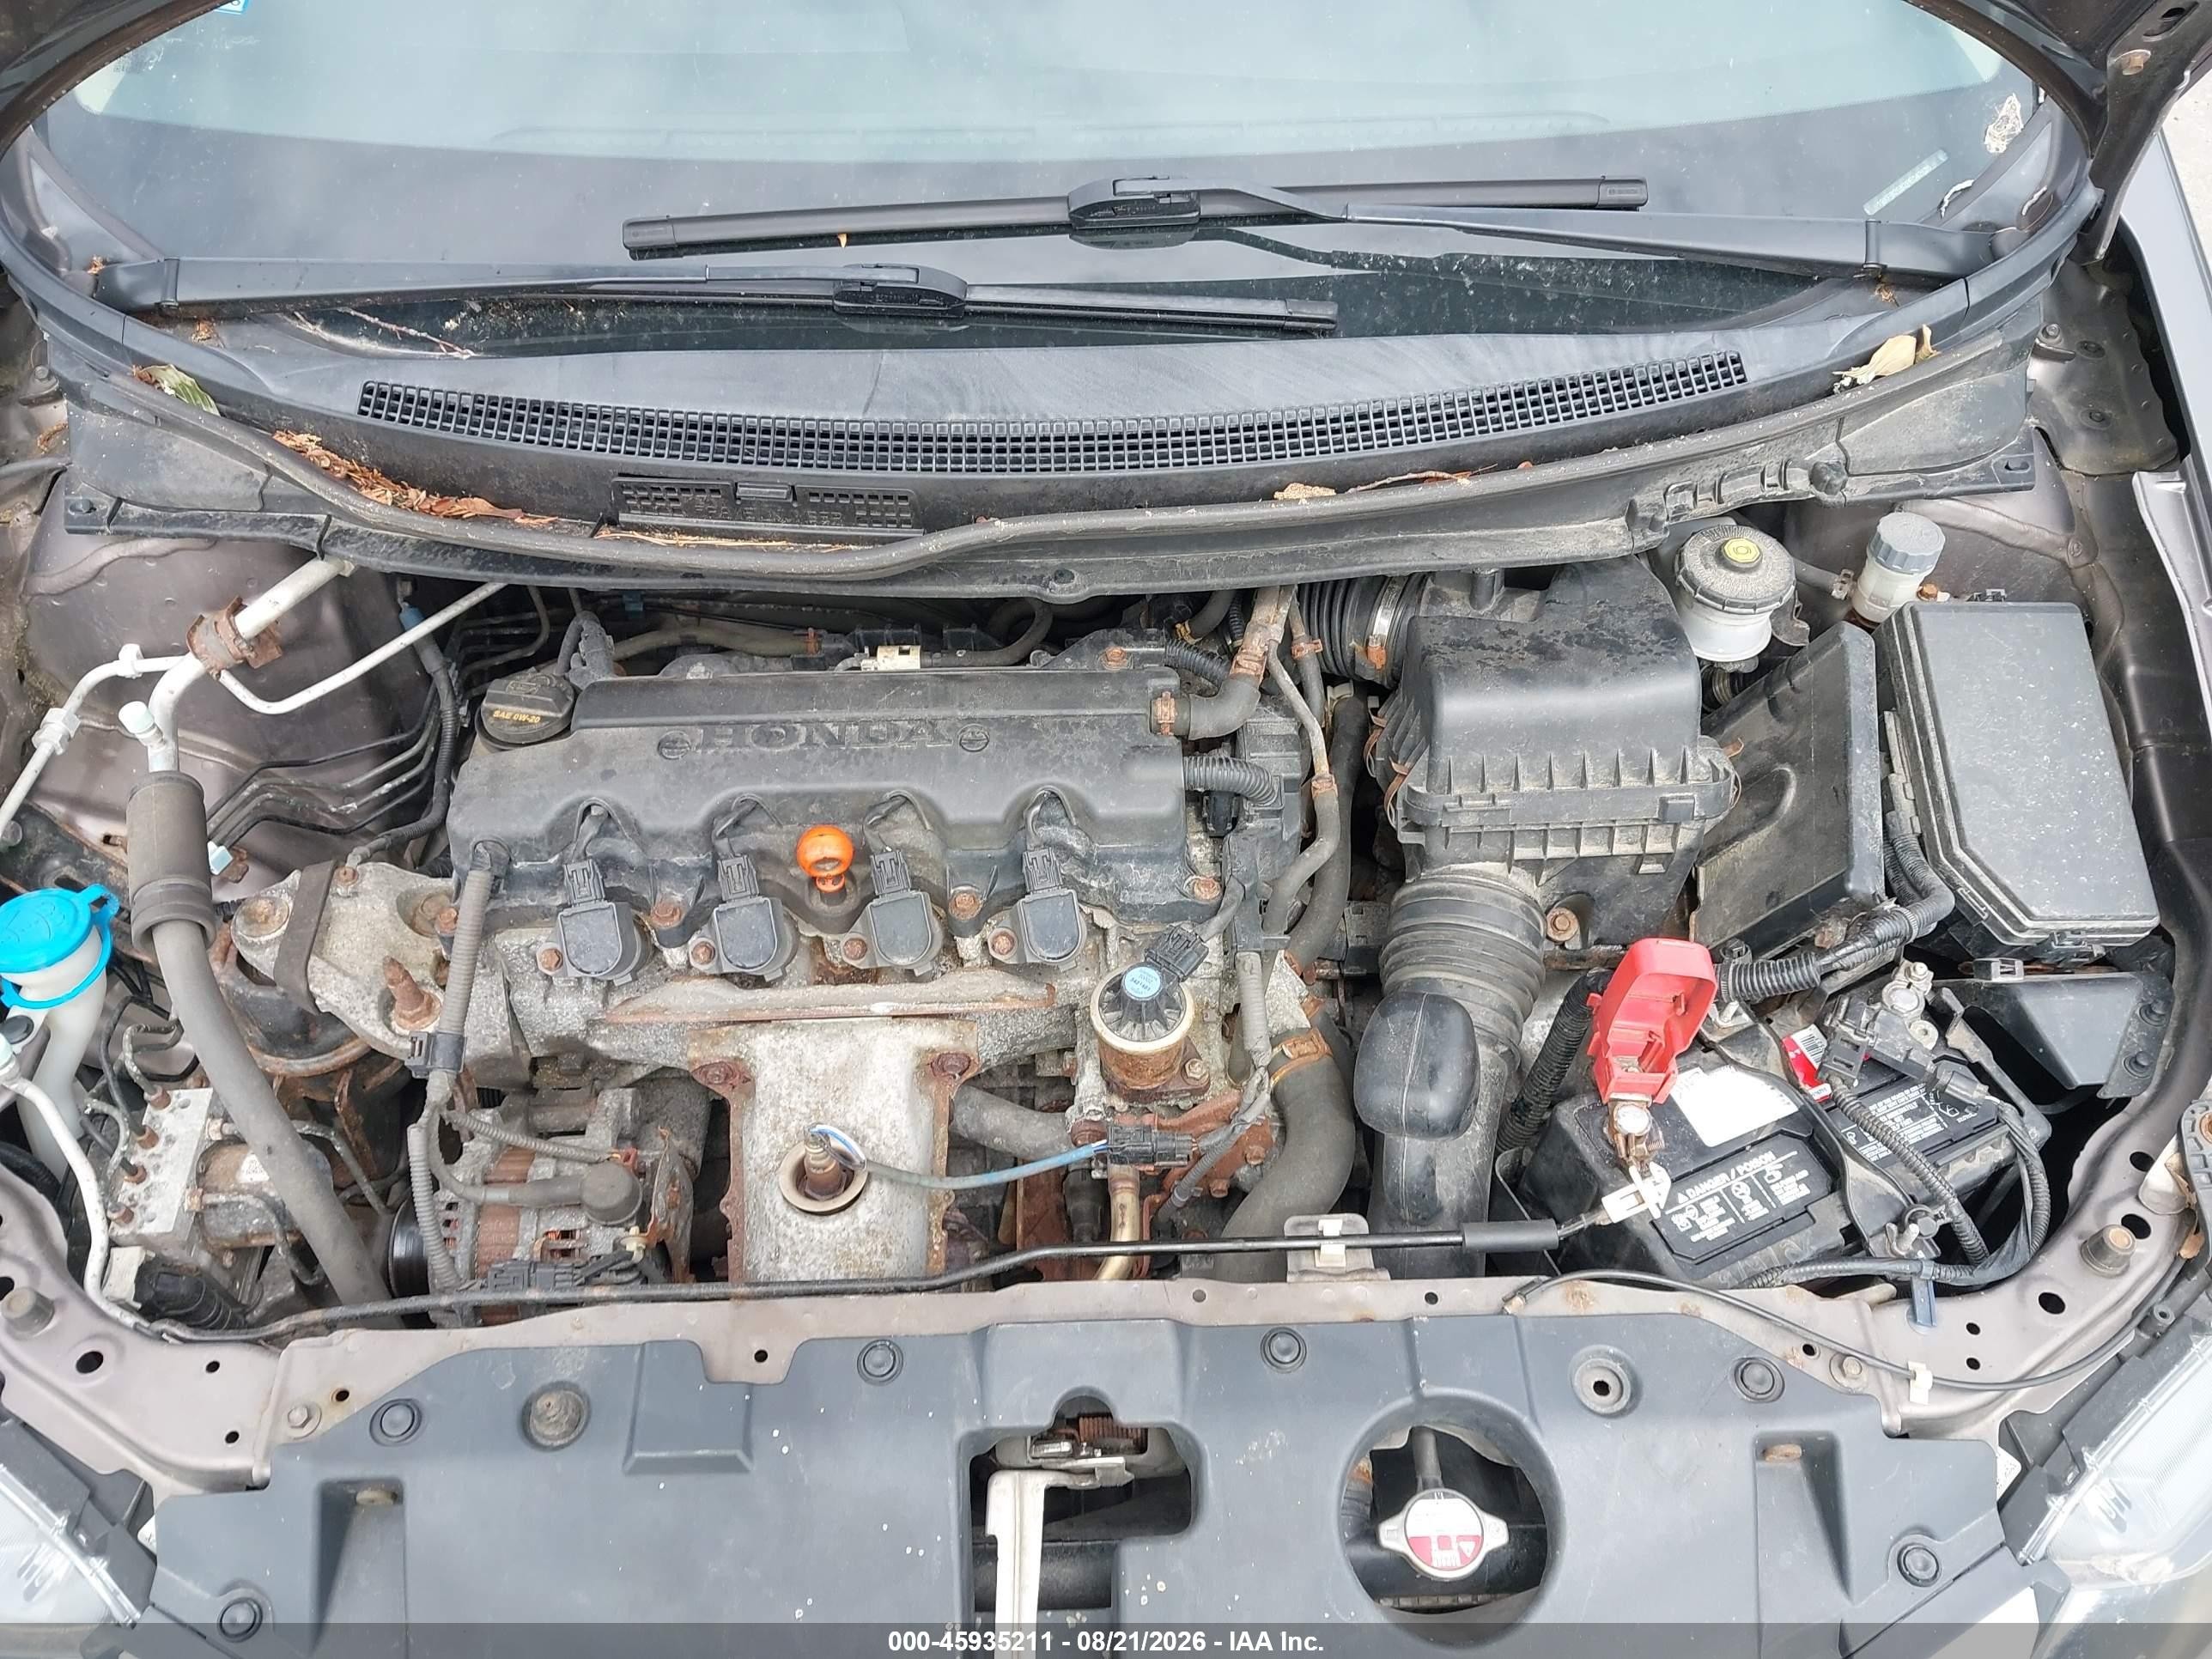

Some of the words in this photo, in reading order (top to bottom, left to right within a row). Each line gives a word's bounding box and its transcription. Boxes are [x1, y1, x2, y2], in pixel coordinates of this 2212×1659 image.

[493, 710, 512, 720] SAE
[514, 713, 541, 724] 0W-20
[696, 723, 954, 750] HONDA
[1686, 1172, 1730, 1199] DANGER
[1737, 1151, 1778, 1176] POISON
